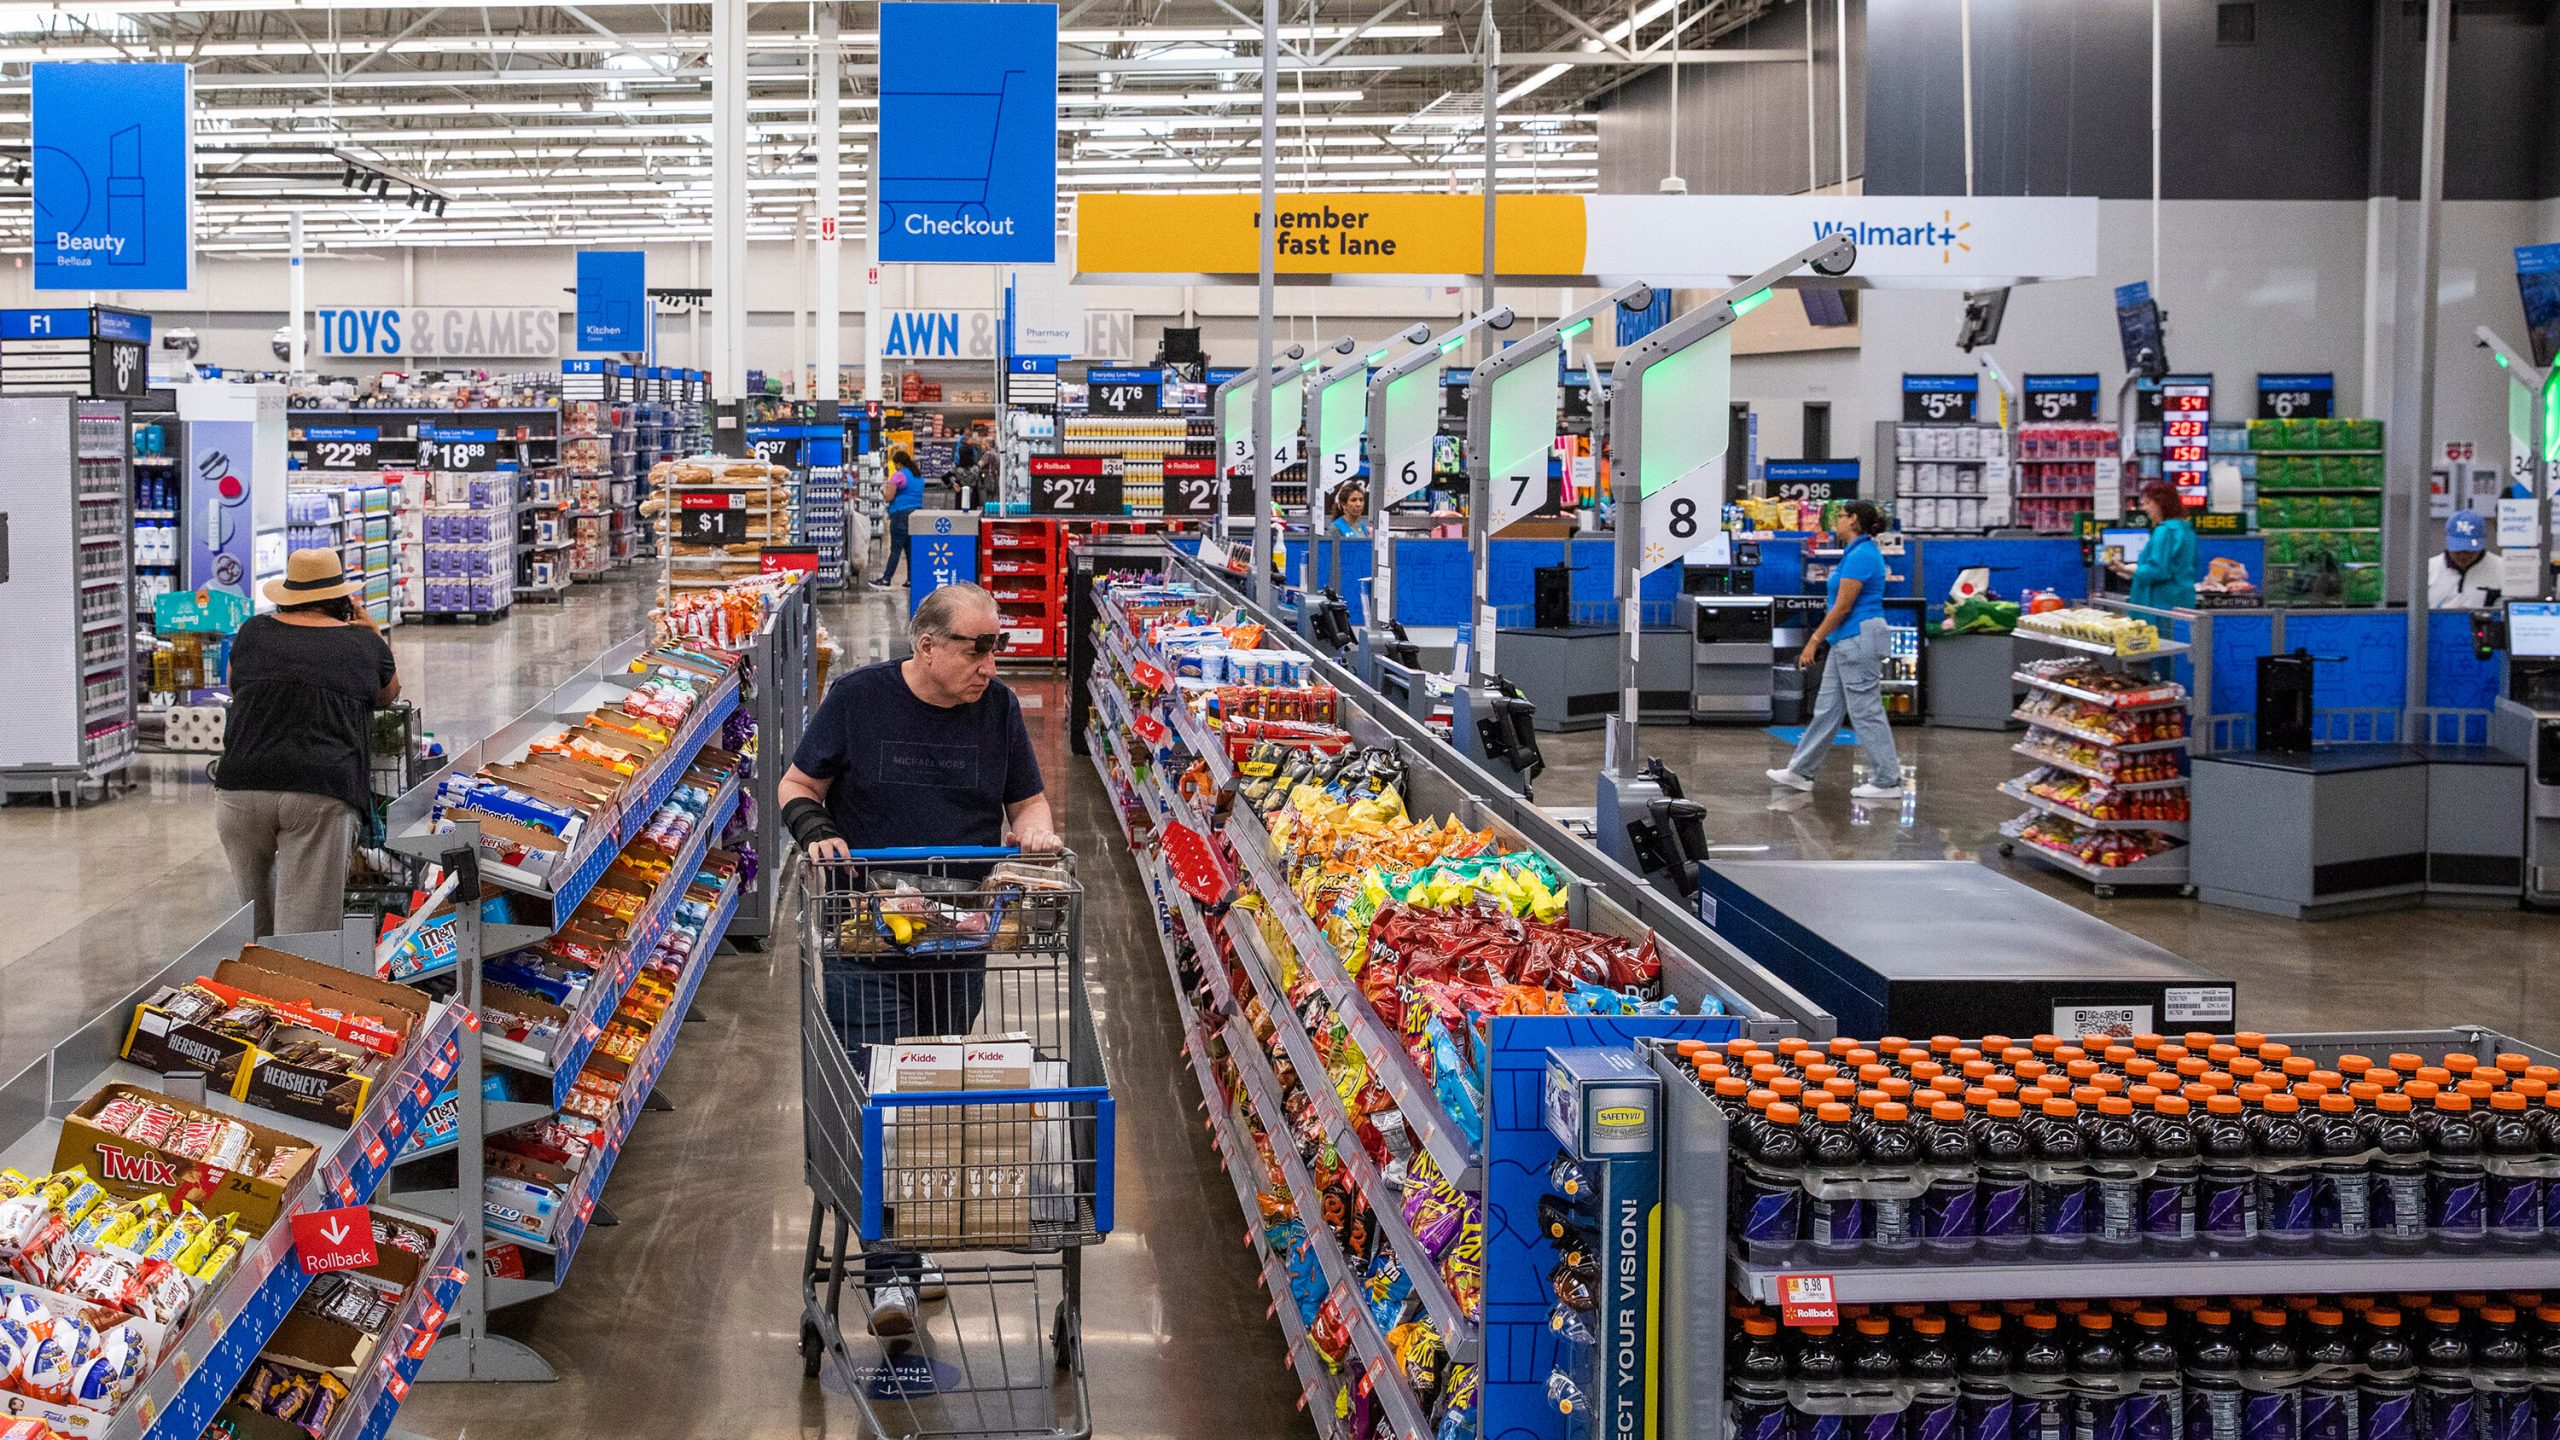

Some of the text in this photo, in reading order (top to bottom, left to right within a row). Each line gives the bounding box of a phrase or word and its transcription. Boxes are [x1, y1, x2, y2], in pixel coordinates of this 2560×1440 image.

[904, 213, 1014, 235] Checkout
[56, 231, 125, 256] Beauty
[1277, 231, 1397, 256] fast lane
[29, 314, 51, 334] F1
[586, 325, 621, 335] Kitchen
[319, 309, 557, 355] TOYS & GAMES
[881, 312, 993, 356] AWN &
[1026, 328, 1070, 338] Pharmacy
[1022, 360, 1036, 371] G1
[2170, 422, 2202, 436] 203
[1235, 441, 1245, 455] 3
[1275, 446, 1288, 463] 4
[2173, 447, 2200, 461] 150
[1044, 462, 1070, 470] Rollback
[1334, 453, 1348, 474] 5
[2514, 456, 2534, 476] 34
[1401, 460, 1417, 485] 6
[2179, 473, 2200, 485] 27
[1510, 476, 1530, 506] 7
[1669, 498, 1697, 538] 8
[2195, 516, 2237, 529] HERE
[1787, 599, 1825, 609] Cart Her
[893, 756, 966, 769] MICHAEL KORS
[529, 850, 544, 861] 24
[1181, 881, 1210, 901] Rollback
[283, 1011, 312, 1024] butter
[350, 1031, 366, 1042] 24
[534, 1027, 547, 1037] 24
[168, 1033, 221, 1065] HERSHEY'S
[911, 1054, 936, 1063] Kidde
[978, 1052, 1004, 1061] Kidde
[264, 1065, 328, 1094] HERSHEY'S
[96, 1143, 177, 1187] Twix
[229, 1178, 253, 1195] 24
[1619, 1199, 1637, 1302] VISION!
[307, 1248, 372, 1271] Rollback
[1804, 1278, 1821, 1291] 6.98
[1797, 1308, 1835, 1317] Rollback
[1617, 1308, 1636, 1388] YOUR
[856, 1375, 933, 1384] Checkou
[43, 1410, 67, 1423] Funko
